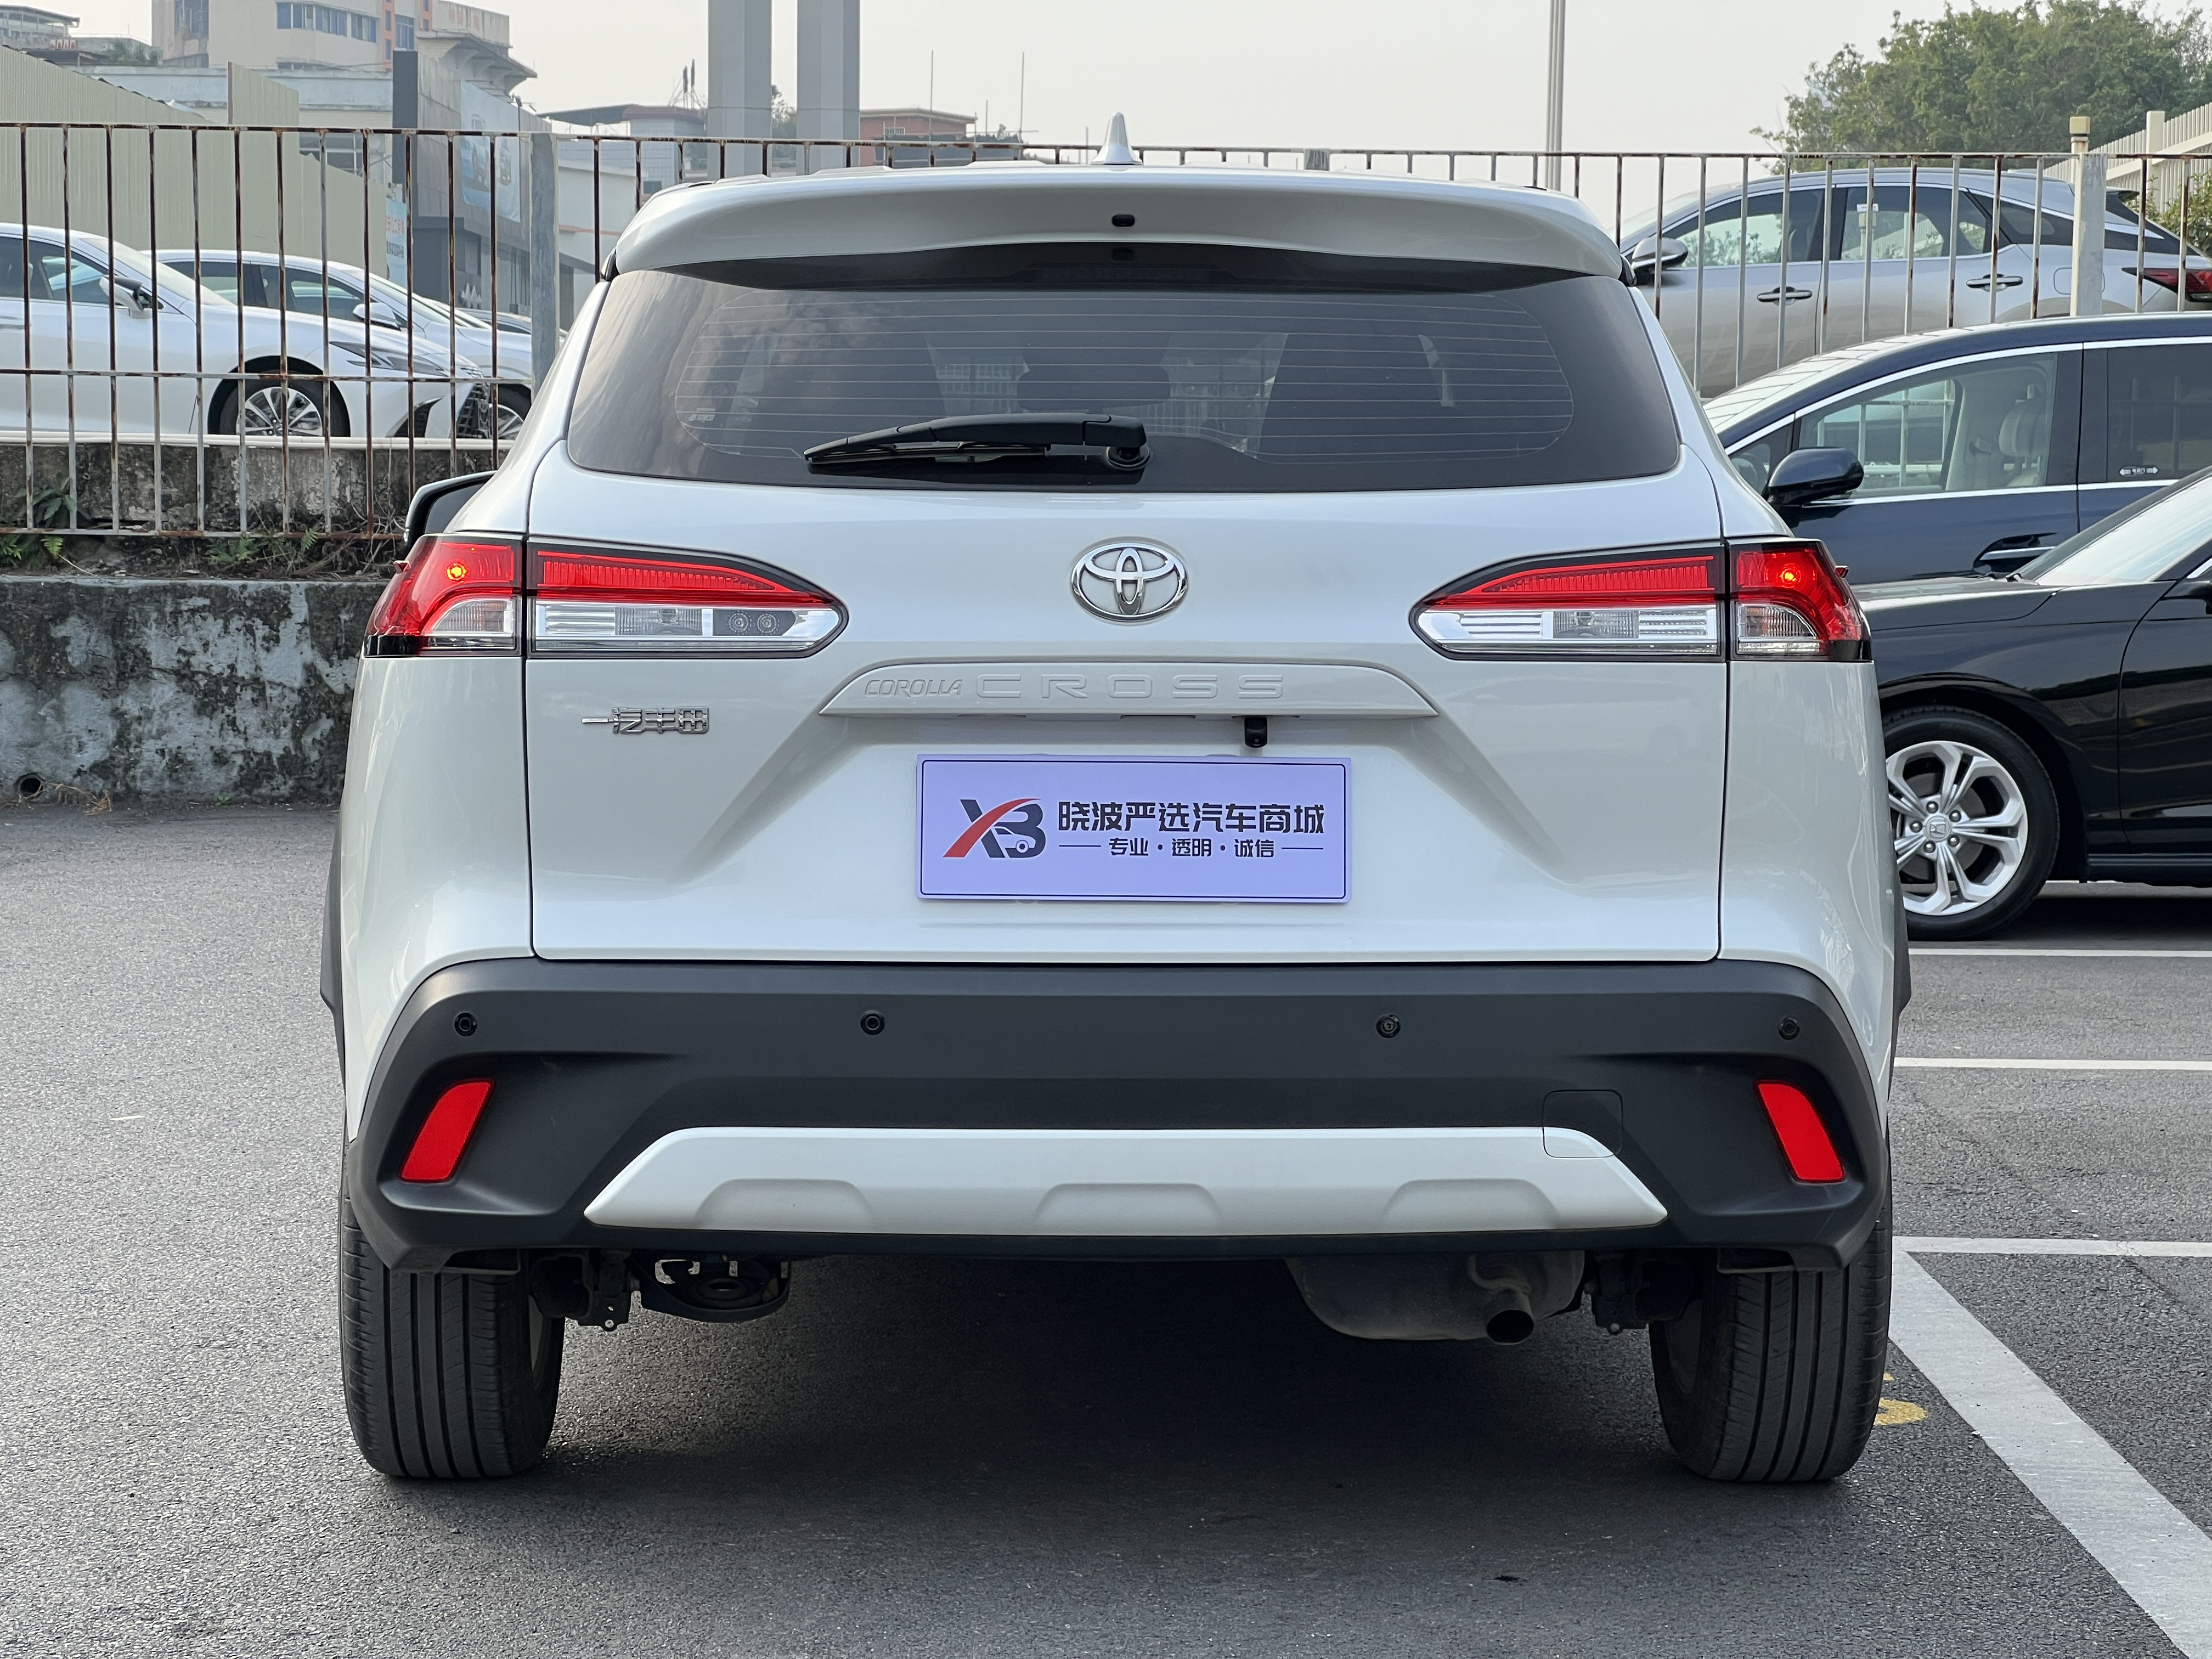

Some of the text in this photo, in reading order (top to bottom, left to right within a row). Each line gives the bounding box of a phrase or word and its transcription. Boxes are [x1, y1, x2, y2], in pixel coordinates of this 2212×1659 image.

[865, 674, 1284, 699] COROLLA CROSS
[582, 706, 709, 735] 一汽丰田
[1058, 801, 1324, 834] 晓波严选汽车商城
